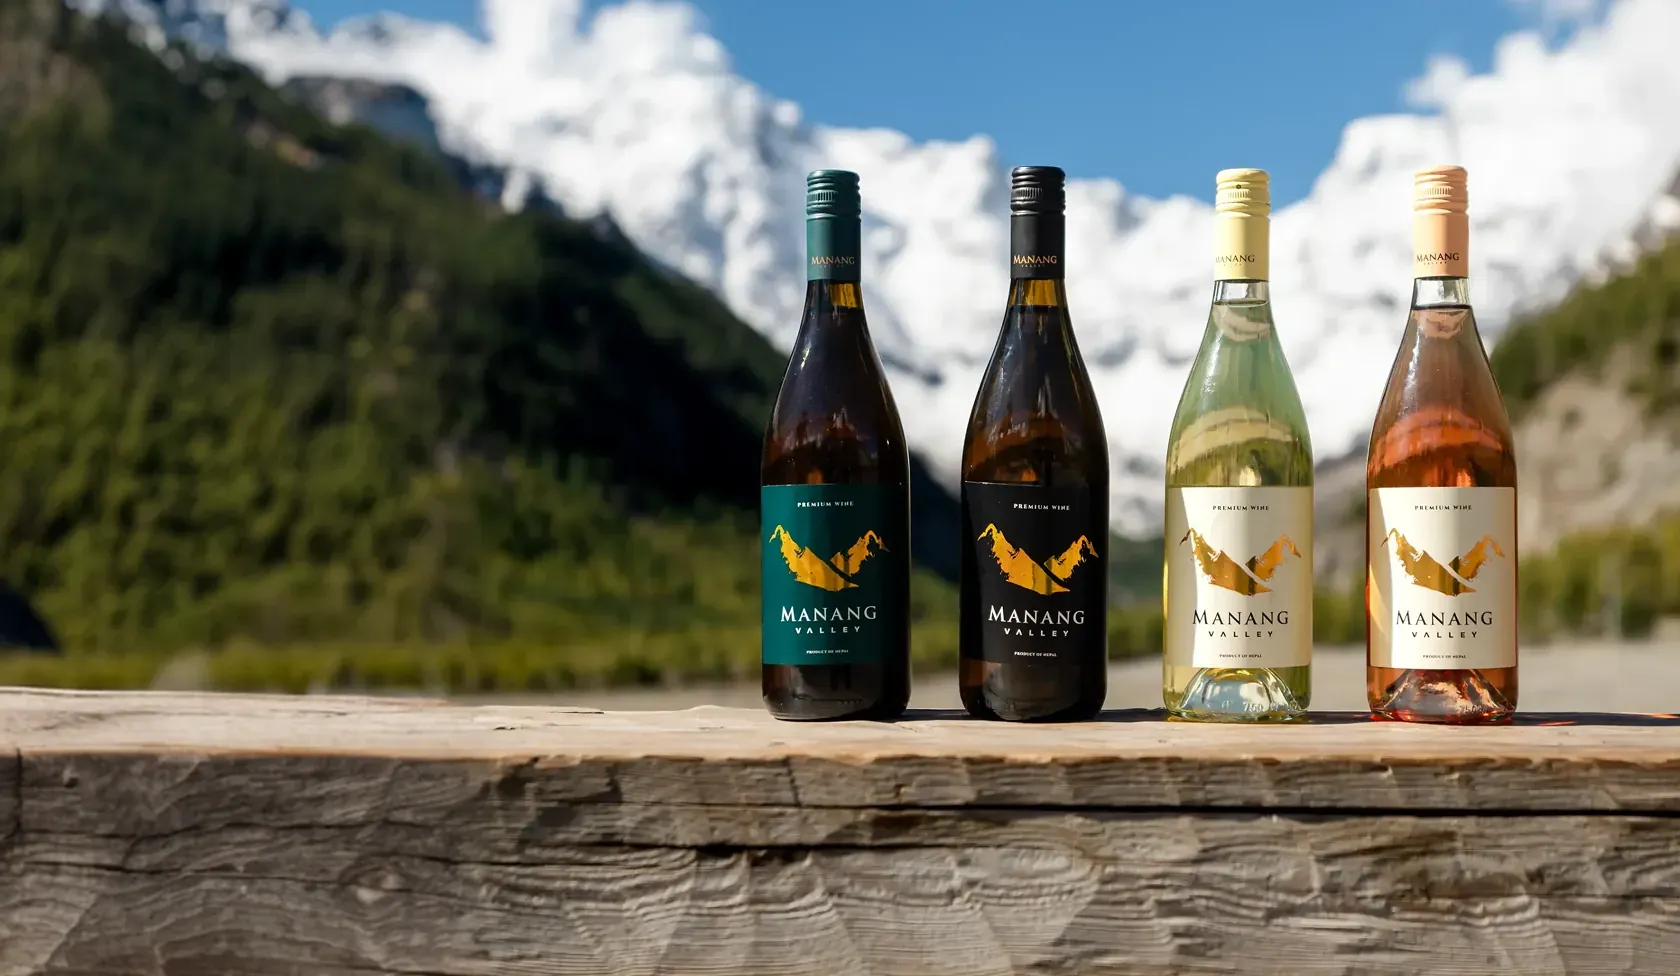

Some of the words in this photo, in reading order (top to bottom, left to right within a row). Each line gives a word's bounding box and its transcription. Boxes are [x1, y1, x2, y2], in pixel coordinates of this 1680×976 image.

[811, 255, 855, 265] MANANG
[1013, 254, 1057, 265] MANANG
[1416, 252, 1460, 262] MANANG
[780, 605, 877, 622] MANANG
[988, 605, 1085, 625] MANANG
[1192, 609, 1289, 626] MANANG
[1396, 609, 1493, 626] MANANG
[795, 626, 861, 635] VALLEY
[1004, 627, 1070, 637] VALLEY
[1411, 631, 1478, 639] VALLEY
